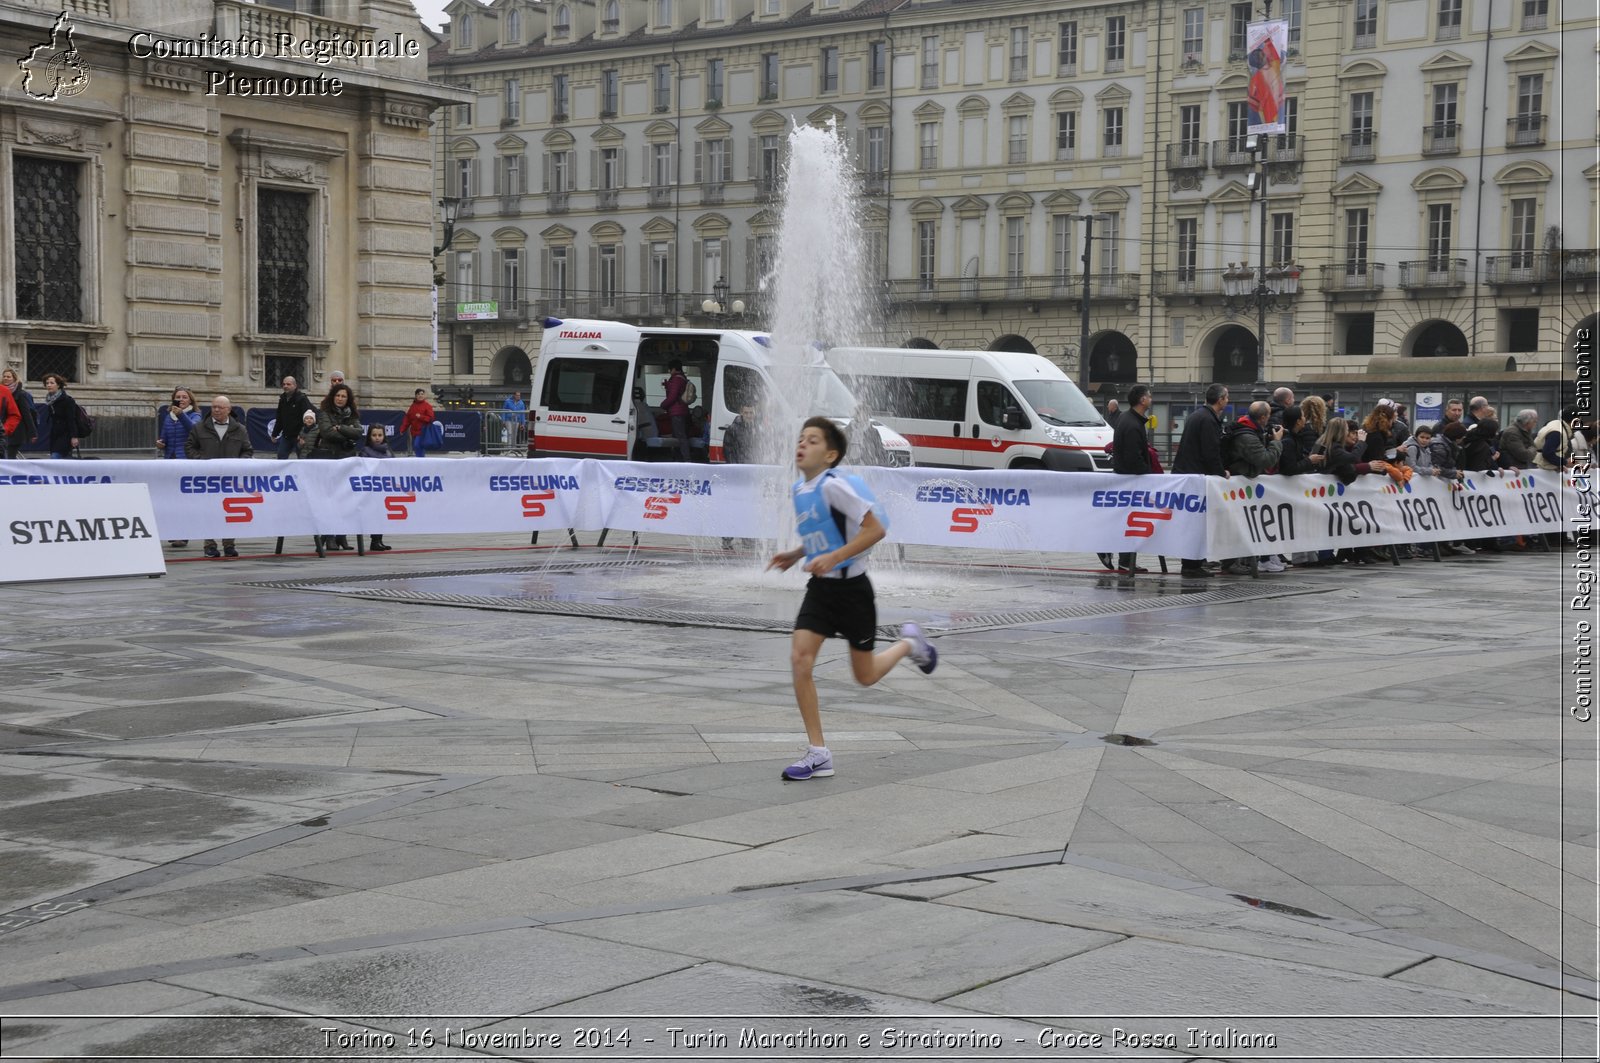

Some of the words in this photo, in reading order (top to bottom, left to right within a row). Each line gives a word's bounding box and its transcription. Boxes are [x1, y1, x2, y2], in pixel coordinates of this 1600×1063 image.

[559, 331, 602, 339] ITALIANA
[547, 414, 587, 423] AVANZATO
[180, 475, 299, 493] ESSELUNGA
[349, 475, 443, 492] ESSELUNGA
[490, 475, 580, 491] ESSELUNGA
[614, 476, 712, 495] ESSELUNGA
[916, 486, 1031, 506] ESSELUNGA
[1396, 497, 1446, 532] iren
[1521, 491, 1563, 524] iren
[1243, 503, 1295, 543] iren
[1324, 500, 1381, 537] iren
[9, 516, 152, 545] STAMPA
